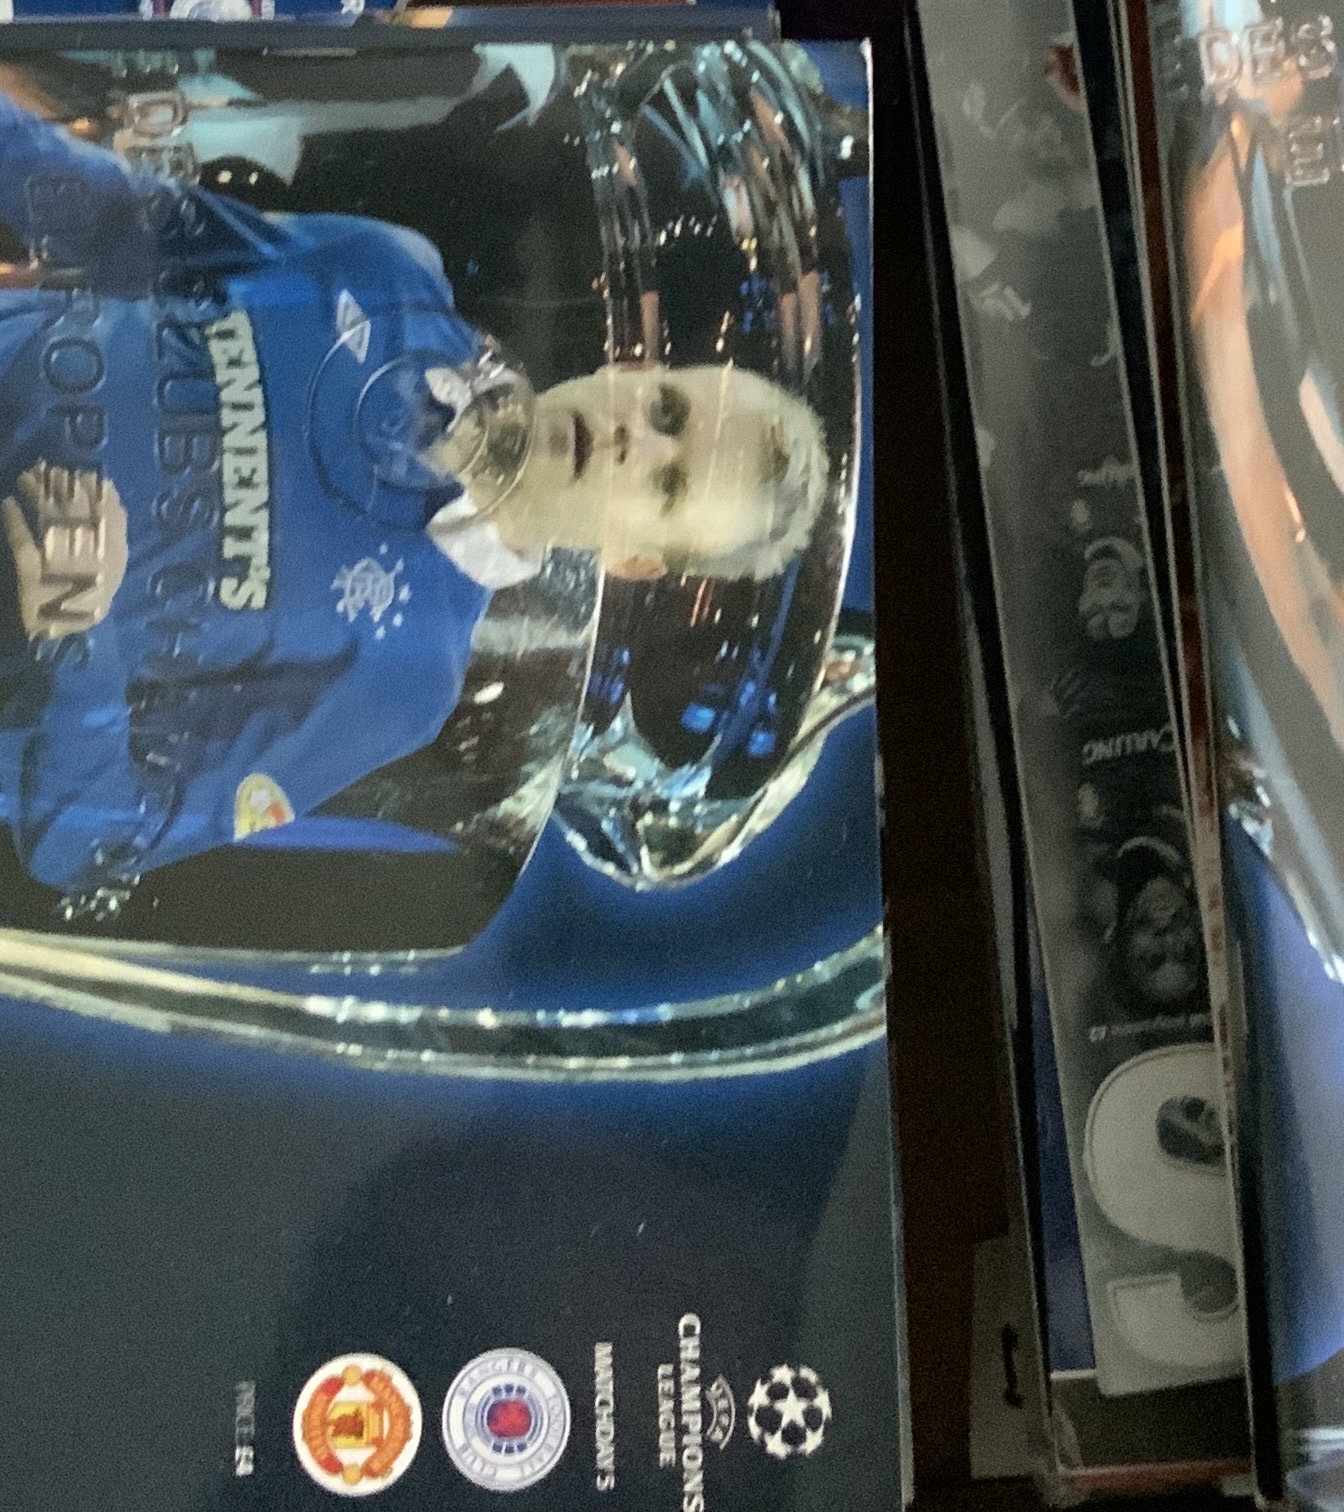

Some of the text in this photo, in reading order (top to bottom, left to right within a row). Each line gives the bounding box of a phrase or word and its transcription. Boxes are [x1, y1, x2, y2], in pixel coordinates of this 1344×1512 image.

[205, 308, 272, 611] TENNENT'S
[594, 1341, 615, 1470] MATCHDAY
[657, 1363, 677, 1469] LEAGUE
[677, 1312, 705, 1512] CHAMPIONS
[709, 1381, 730, 1443] UEFA
